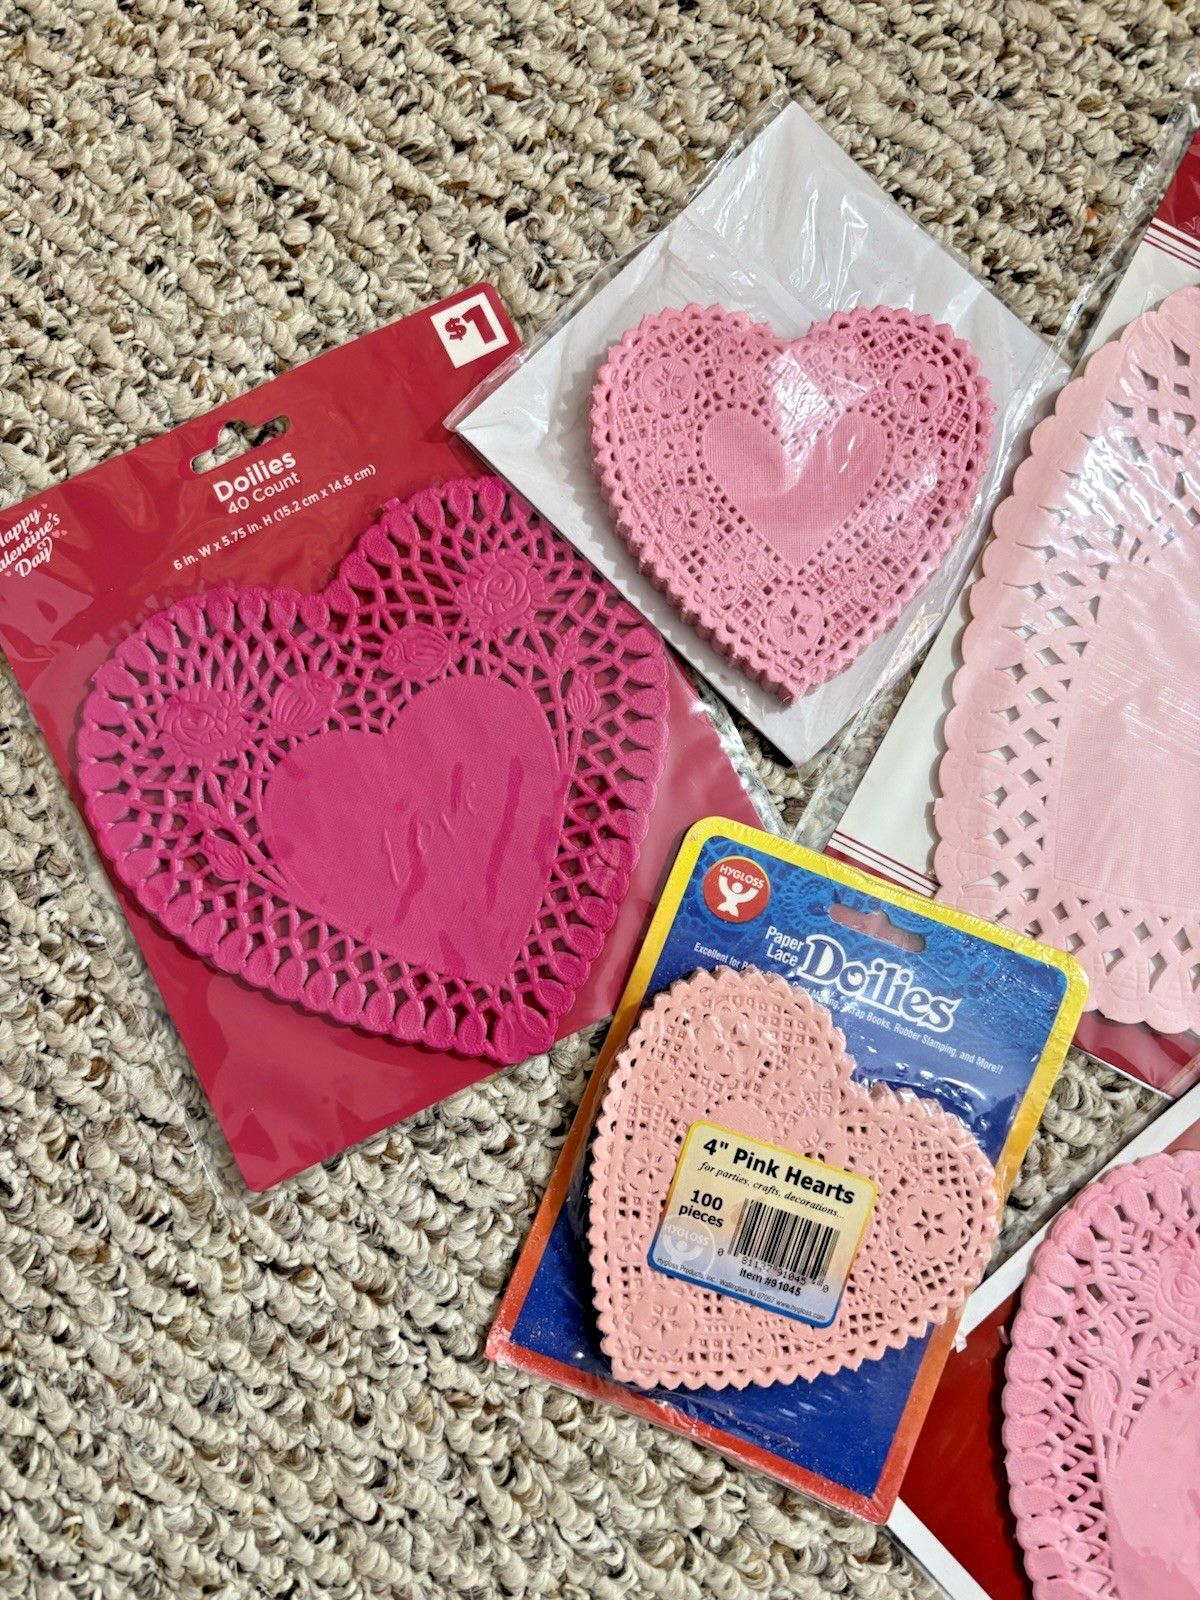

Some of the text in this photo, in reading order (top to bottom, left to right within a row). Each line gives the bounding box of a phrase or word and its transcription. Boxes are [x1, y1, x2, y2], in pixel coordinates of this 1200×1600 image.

[444, 304, 498, 345] $1
[213, 451, 297, 502] Doilies
[228, 472, 301, 515] 40 Count
[173, 464, 377, 571] 6 in. W x 5.75 in. H (15.2 cm x 14.6 cm)
[0, 513, 60, 572] alentine's
[14, 536, 53, 577] Day
[719, 864, 765, 889] HYGLOSS
[694, 942, 741, 968] Excellent for
[765, 925, 805, 952] Paper
[766, 943, 798, 967] Lace
[797, 934, 962, 1032] Doilies
[866, 1011, 891, 1031] Books,
[894, 1023, 921, 1042] Rubber
[921, 1035, 958, 1058] Stamping,
[959, 1050, 975, 1063] and
[975, 1056, 1005, 1075] More!!
[698, 1161, 716, 1176] for
[715, 1168, 750, 1187] parties,
[753, 1180, 781, 1198] crafts,
[703, 1139, 855, 1204] 4" Pink Hearts
[678, 1204, 724, 1228] pieces
[690, 1189, 723, 1211] 100
[664, 1222, 710, 1246] HYGLOSS
[717, 1247, 724, 1257] 0
[657, 1257, 679, 1270] Hygloss
[749, 1288, 758, 1297] NJ
[776, 1299, 827, 1321] www.hygloss.com
[739, 1267, 801, 1296] Item #91045
